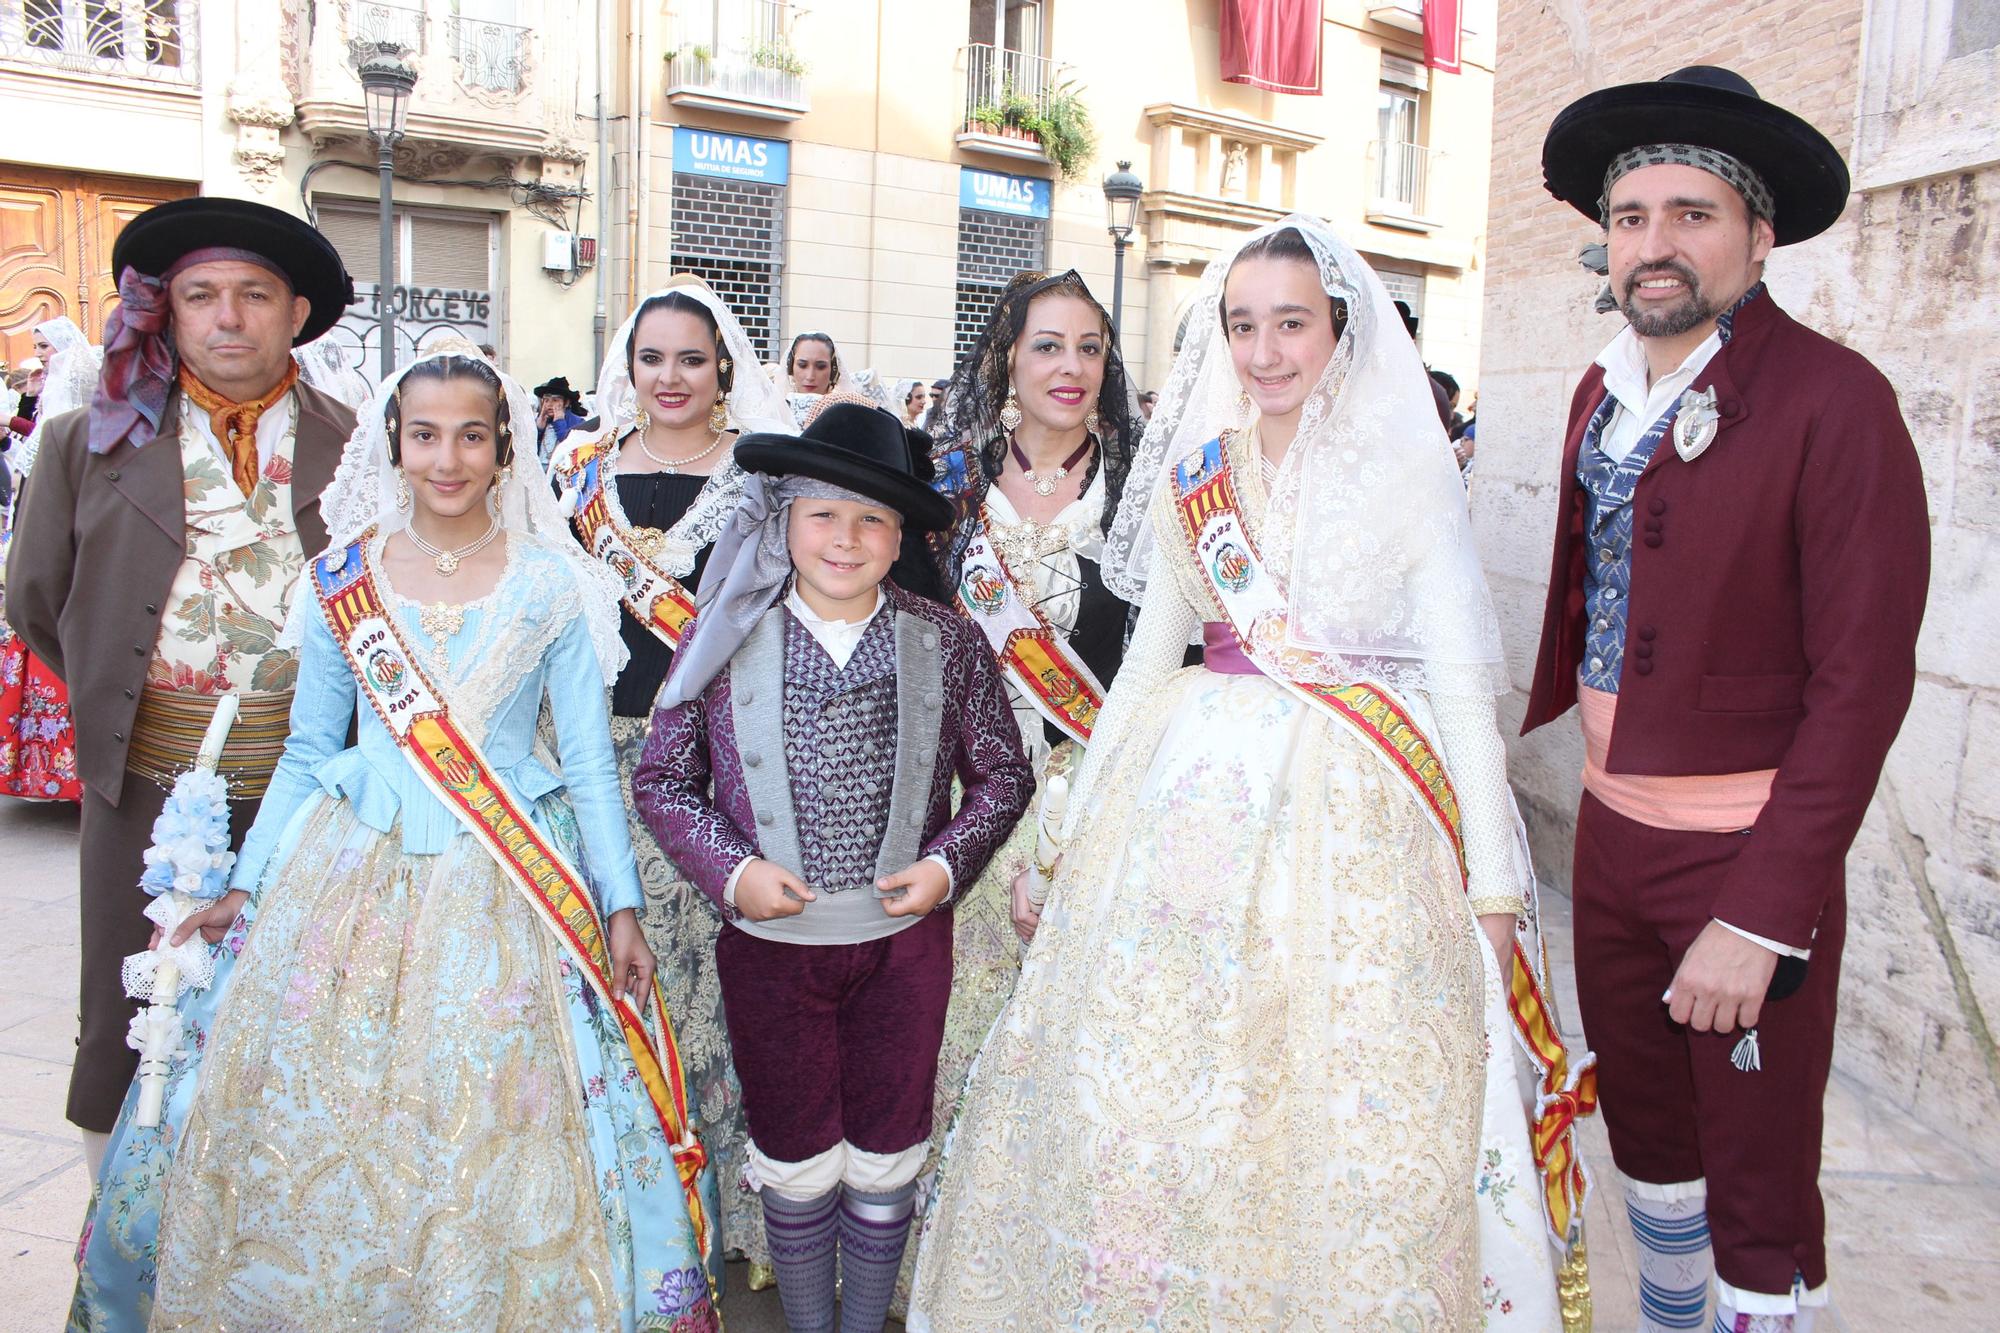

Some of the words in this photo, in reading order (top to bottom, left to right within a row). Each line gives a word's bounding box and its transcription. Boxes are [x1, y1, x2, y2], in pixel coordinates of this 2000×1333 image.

[691, 133, 768, 167] UMAS
[973, 172, 1034, 203] UMAS
[596, 535, 613, 559] 2020
[1202, 522, 1231, 552] 2022
[631, 578, 654, 603] 2021
[356, 630, 385, 657] 2020
[389, 688, 420, 714] 2021
